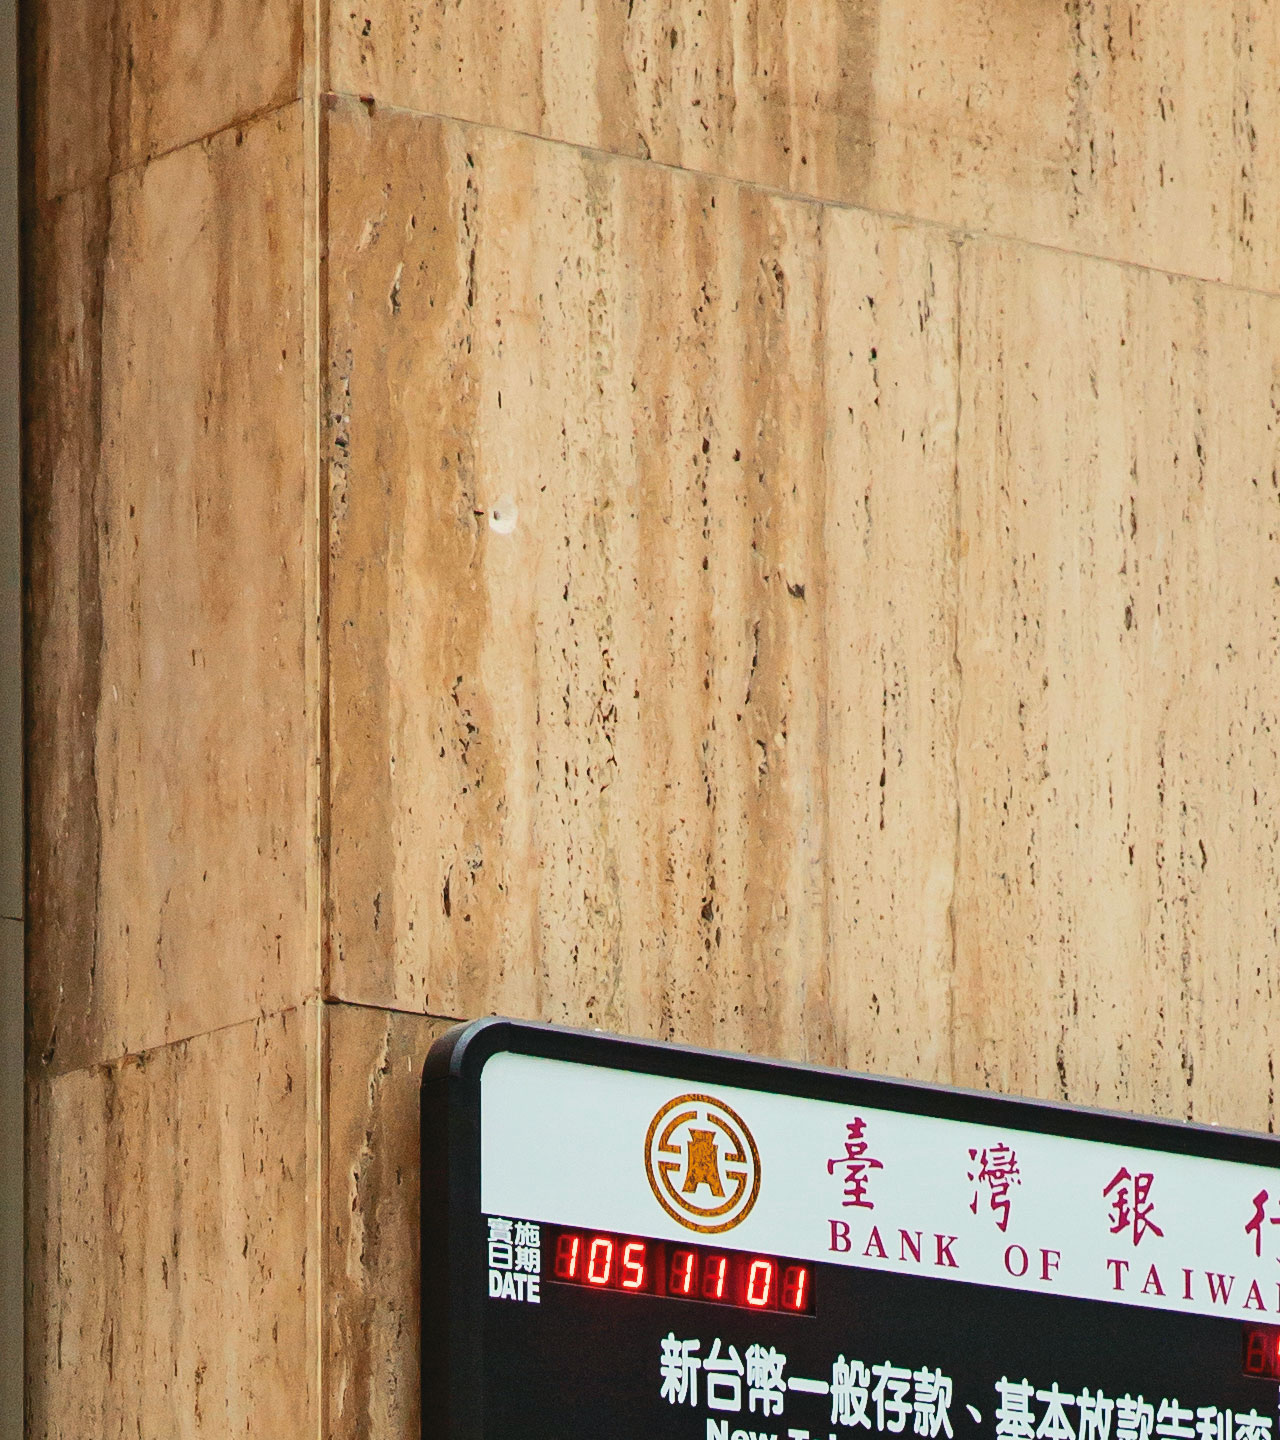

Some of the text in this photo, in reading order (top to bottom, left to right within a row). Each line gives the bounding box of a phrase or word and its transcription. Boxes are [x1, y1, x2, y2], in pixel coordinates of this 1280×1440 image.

[488, 1218, 541, 1247] 實施
[488, 1245, 541, 1274] 日期
[828, 1220, 960, 1268] BANK
[1004, 1244, 1061, 1281] OF
[489, 1270, 540, 1303] DATE
